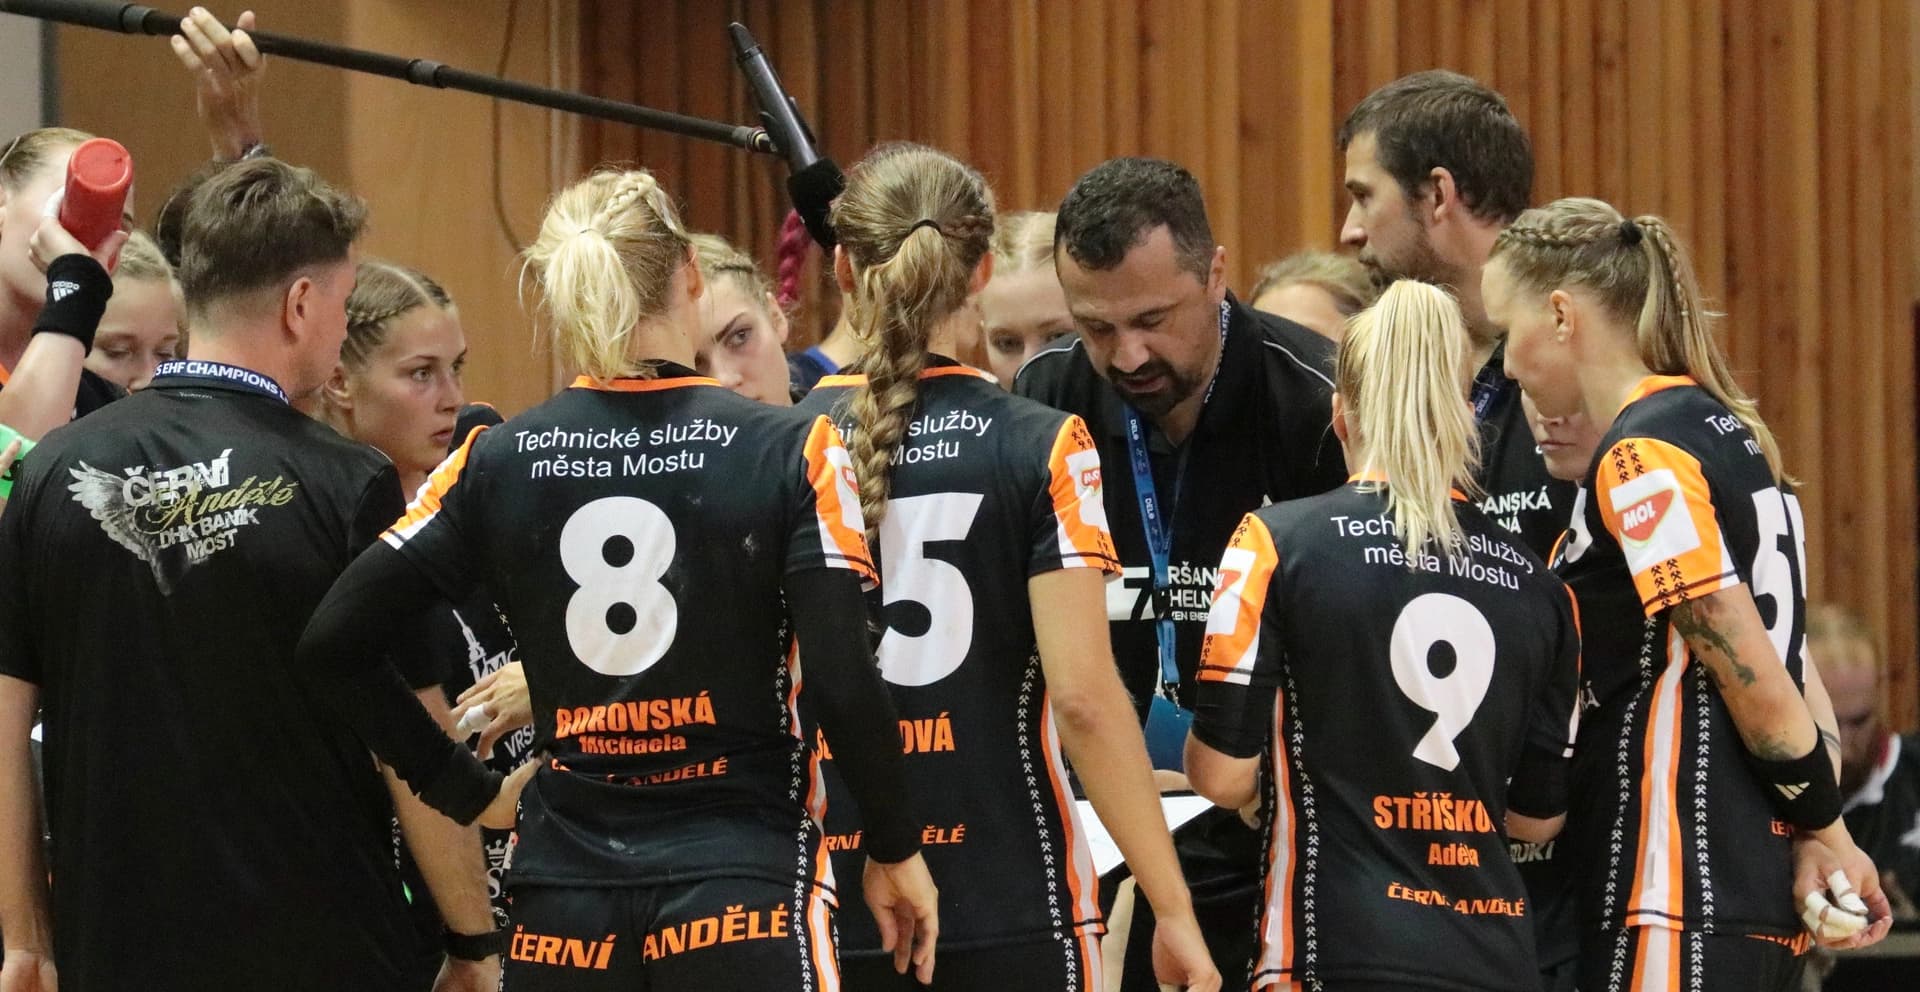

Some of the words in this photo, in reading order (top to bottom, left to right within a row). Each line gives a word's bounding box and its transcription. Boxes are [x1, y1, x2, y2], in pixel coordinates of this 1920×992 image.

[162, 362, 185, 375] EHF
[187, 362, 278, 394] CHAMPIONS
[515, 427, 641, 453] Technické
[649, 419, 739, 447] služby
[908, 409, 992, 438] služby
[121, 448, 234, 507] ČERNÍ
[531, 455, 612, 479] města
[622, 449, 705, 477] Mostu
[159, 520, 199, 549] DHK
[199, 504, 260, 537] BANÍK
[1622, 501, 1657, 531] MOL
[184, 529, 239, 561] MOST
[560, 497, 676, 676] 8
[877, 492, 984, 686] 5
[1448, 557, 1520, 591] Mostu
[1389, 593, 1494, 770] 9
[555, 690, 717, 740] BOROVSKÁ
[578, 733, 688, 755] Michaela
[510, 924, 617, 970] ČERNÍ
[642, 903, 790, 965] ANDĚLÉ
